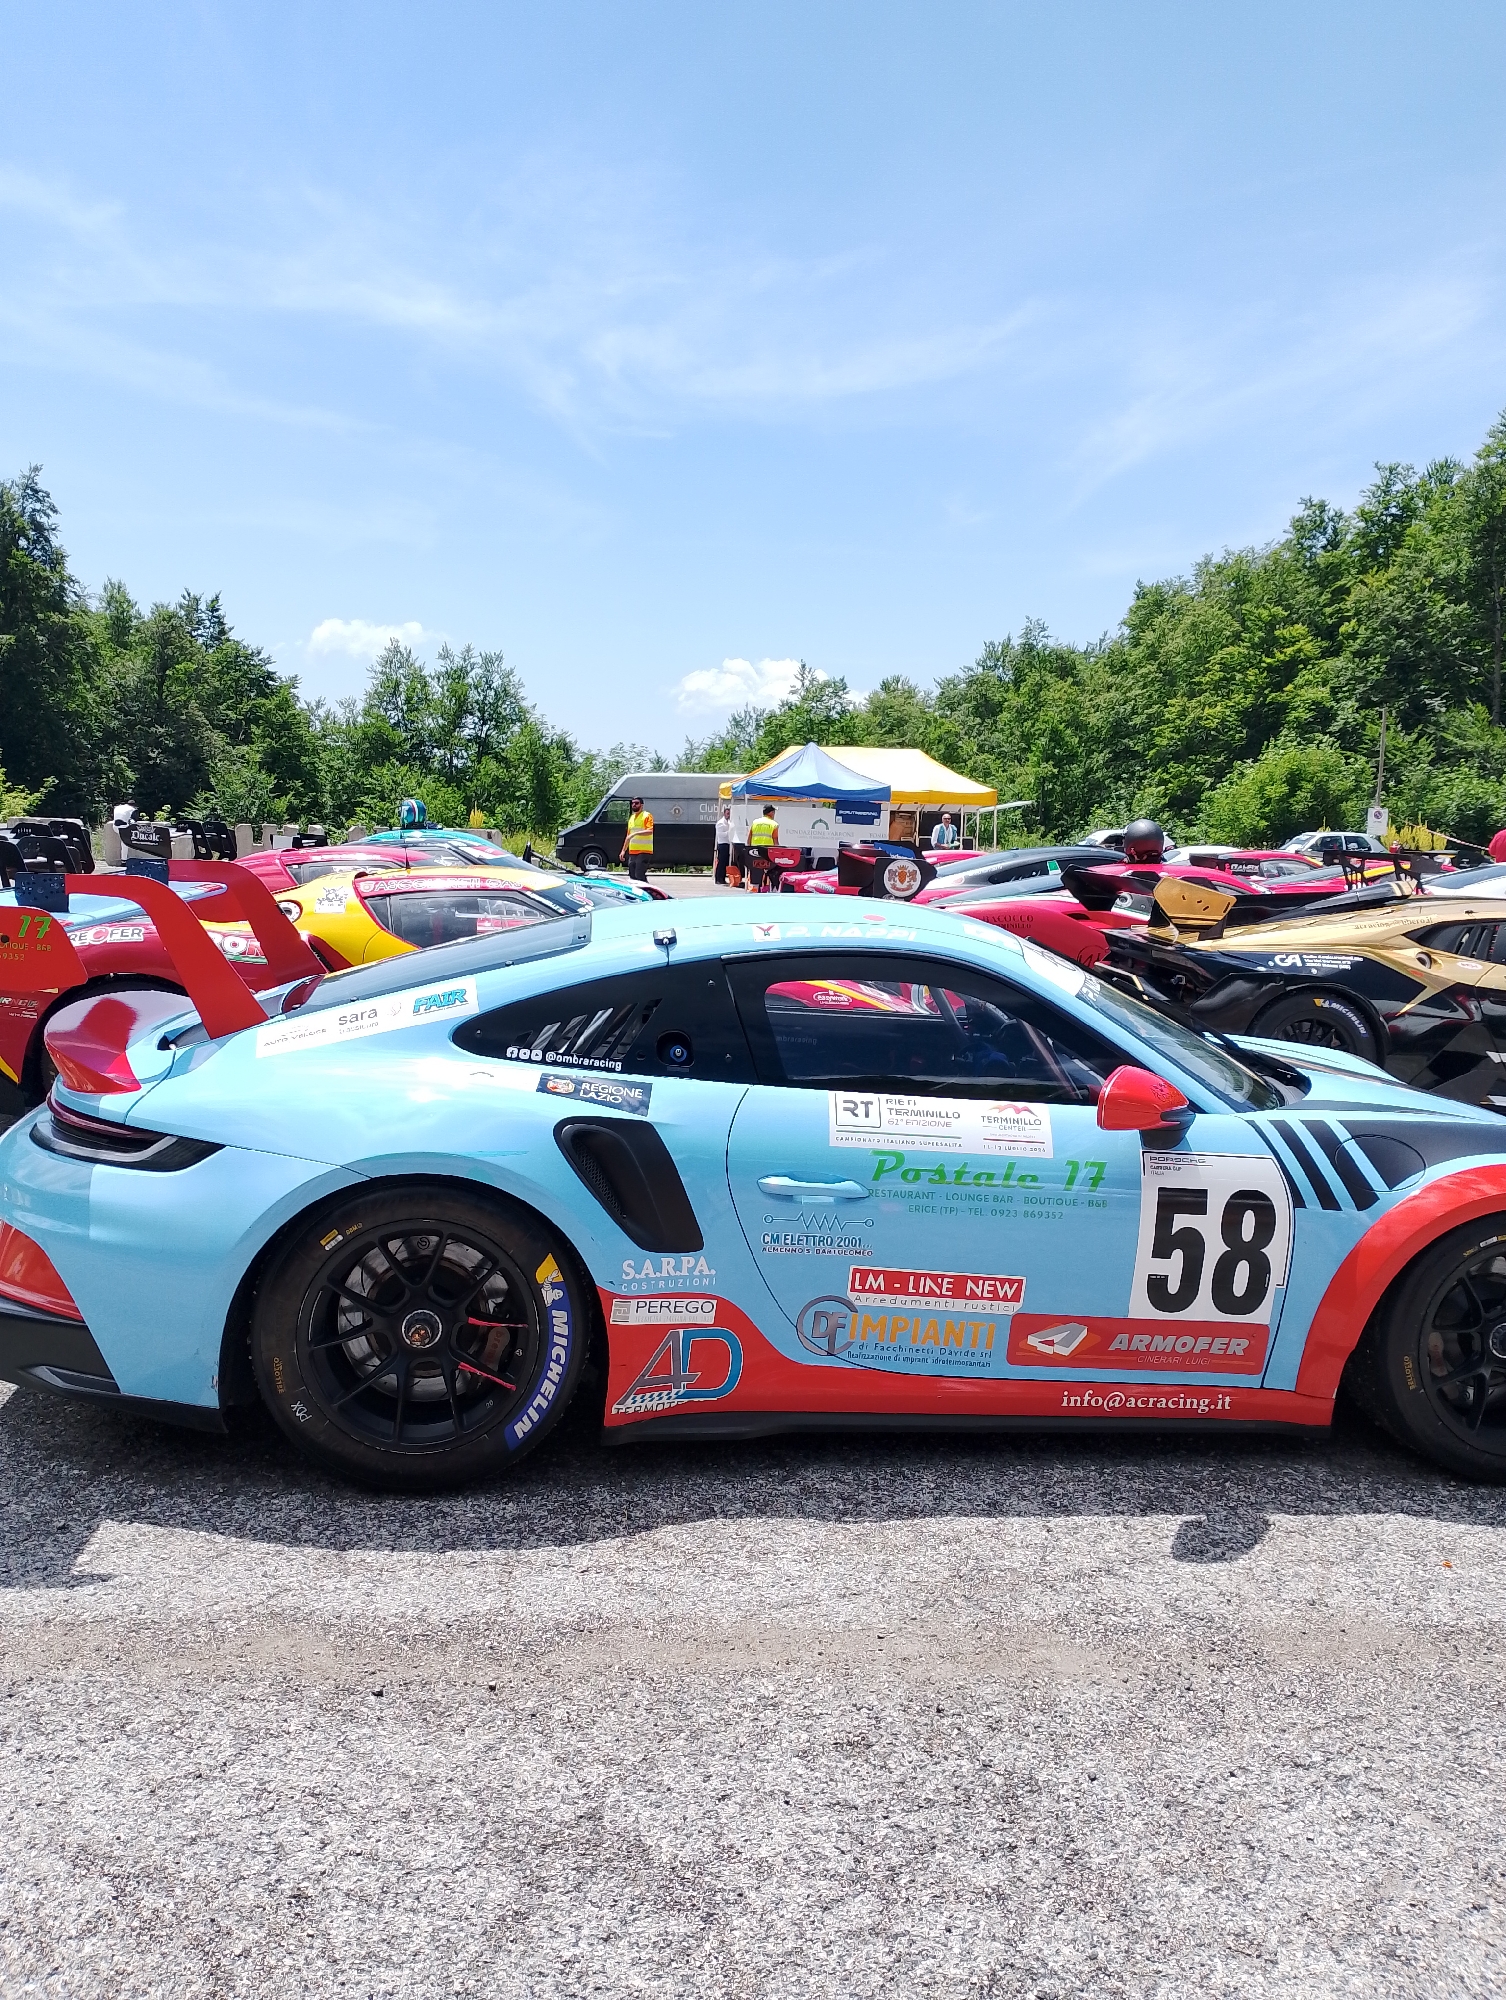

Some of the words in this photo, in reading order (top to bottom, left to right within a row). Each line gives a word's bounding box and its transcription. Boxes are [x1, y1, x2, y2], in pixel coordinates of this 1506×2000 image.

[18, 915, 52, 938] 17
[412, 989, 468, 1014] FAIR
[338, 1008, 378, 1026] sara
[546, 1052, 622, 1071] @ombraracing
[580, 1082, 643, 1098] REGIONE
[580, 1090, 622, 1103] LAZIO
[887, 1108, 961, 1120] TERMINILLO
[980, 1116, 1042, 1126] TERMINILLO
[906, 1120, 953, 1128] EDIZIONE
[1150, 1156, 1206, 1164] PORSCHE
[868, 1149, 1046, 1190] Postale
[1063, 1160, 1109, 1192] 17
[867, 1188, 936, 1200] RESTAURANT
[946, 1192, 990, 1204] LOUNGE
[992, 1194, 1014, 1205] BAR
[1023, 1196, 1079, 1207] BOUTIQUE
[1087, 1199, 1108, 1208] B&B
[908, 1204, 938, 1214] ERICE
[940, 1206, 958, 1217] (TP)
[990, 1208, 1018, 1219] 0923
[1022, 1210, 1064, 1220] 869352
[762, 1232, 780, 1244] CM
[783, 1233, 833, 1247] ELETTRO
[761, 1246, 804, 1254] ALMENNO
[815, 1248, 873, 1256] BARTOLOMEO
[1146, 1186, 1276, 1316] 58
[622, 1277, 716, 1292] COSTRUZIONI
[853, 1272, 884, 1292] LM
[908, 1276, 954, 1296] LINE
[966, 1279, 1018, 1300] NEW
[636, 1300, 714, 1315] PEREGO
[964, 1302, 1015, 1313] rustici
[848, 1314, 996, 1350] IMPIANTI
[858, 1342, 868, 1350] di
[874, 1342, 934, 1355] Facchinetti
[940, 1347, 976, 1358] Davide
[980, 1350, 992, 1358] srl
[1108, 1334, 1250, 1356] ARMOFER
[847, 1350, 892, 1362] Realizzazione
[1185, 1356, 1211, 1366] LUIGI
[512, 1308, 570, 1440] MICHELIN
[1060, 1390, 1233, 1414] info@acracing.it
